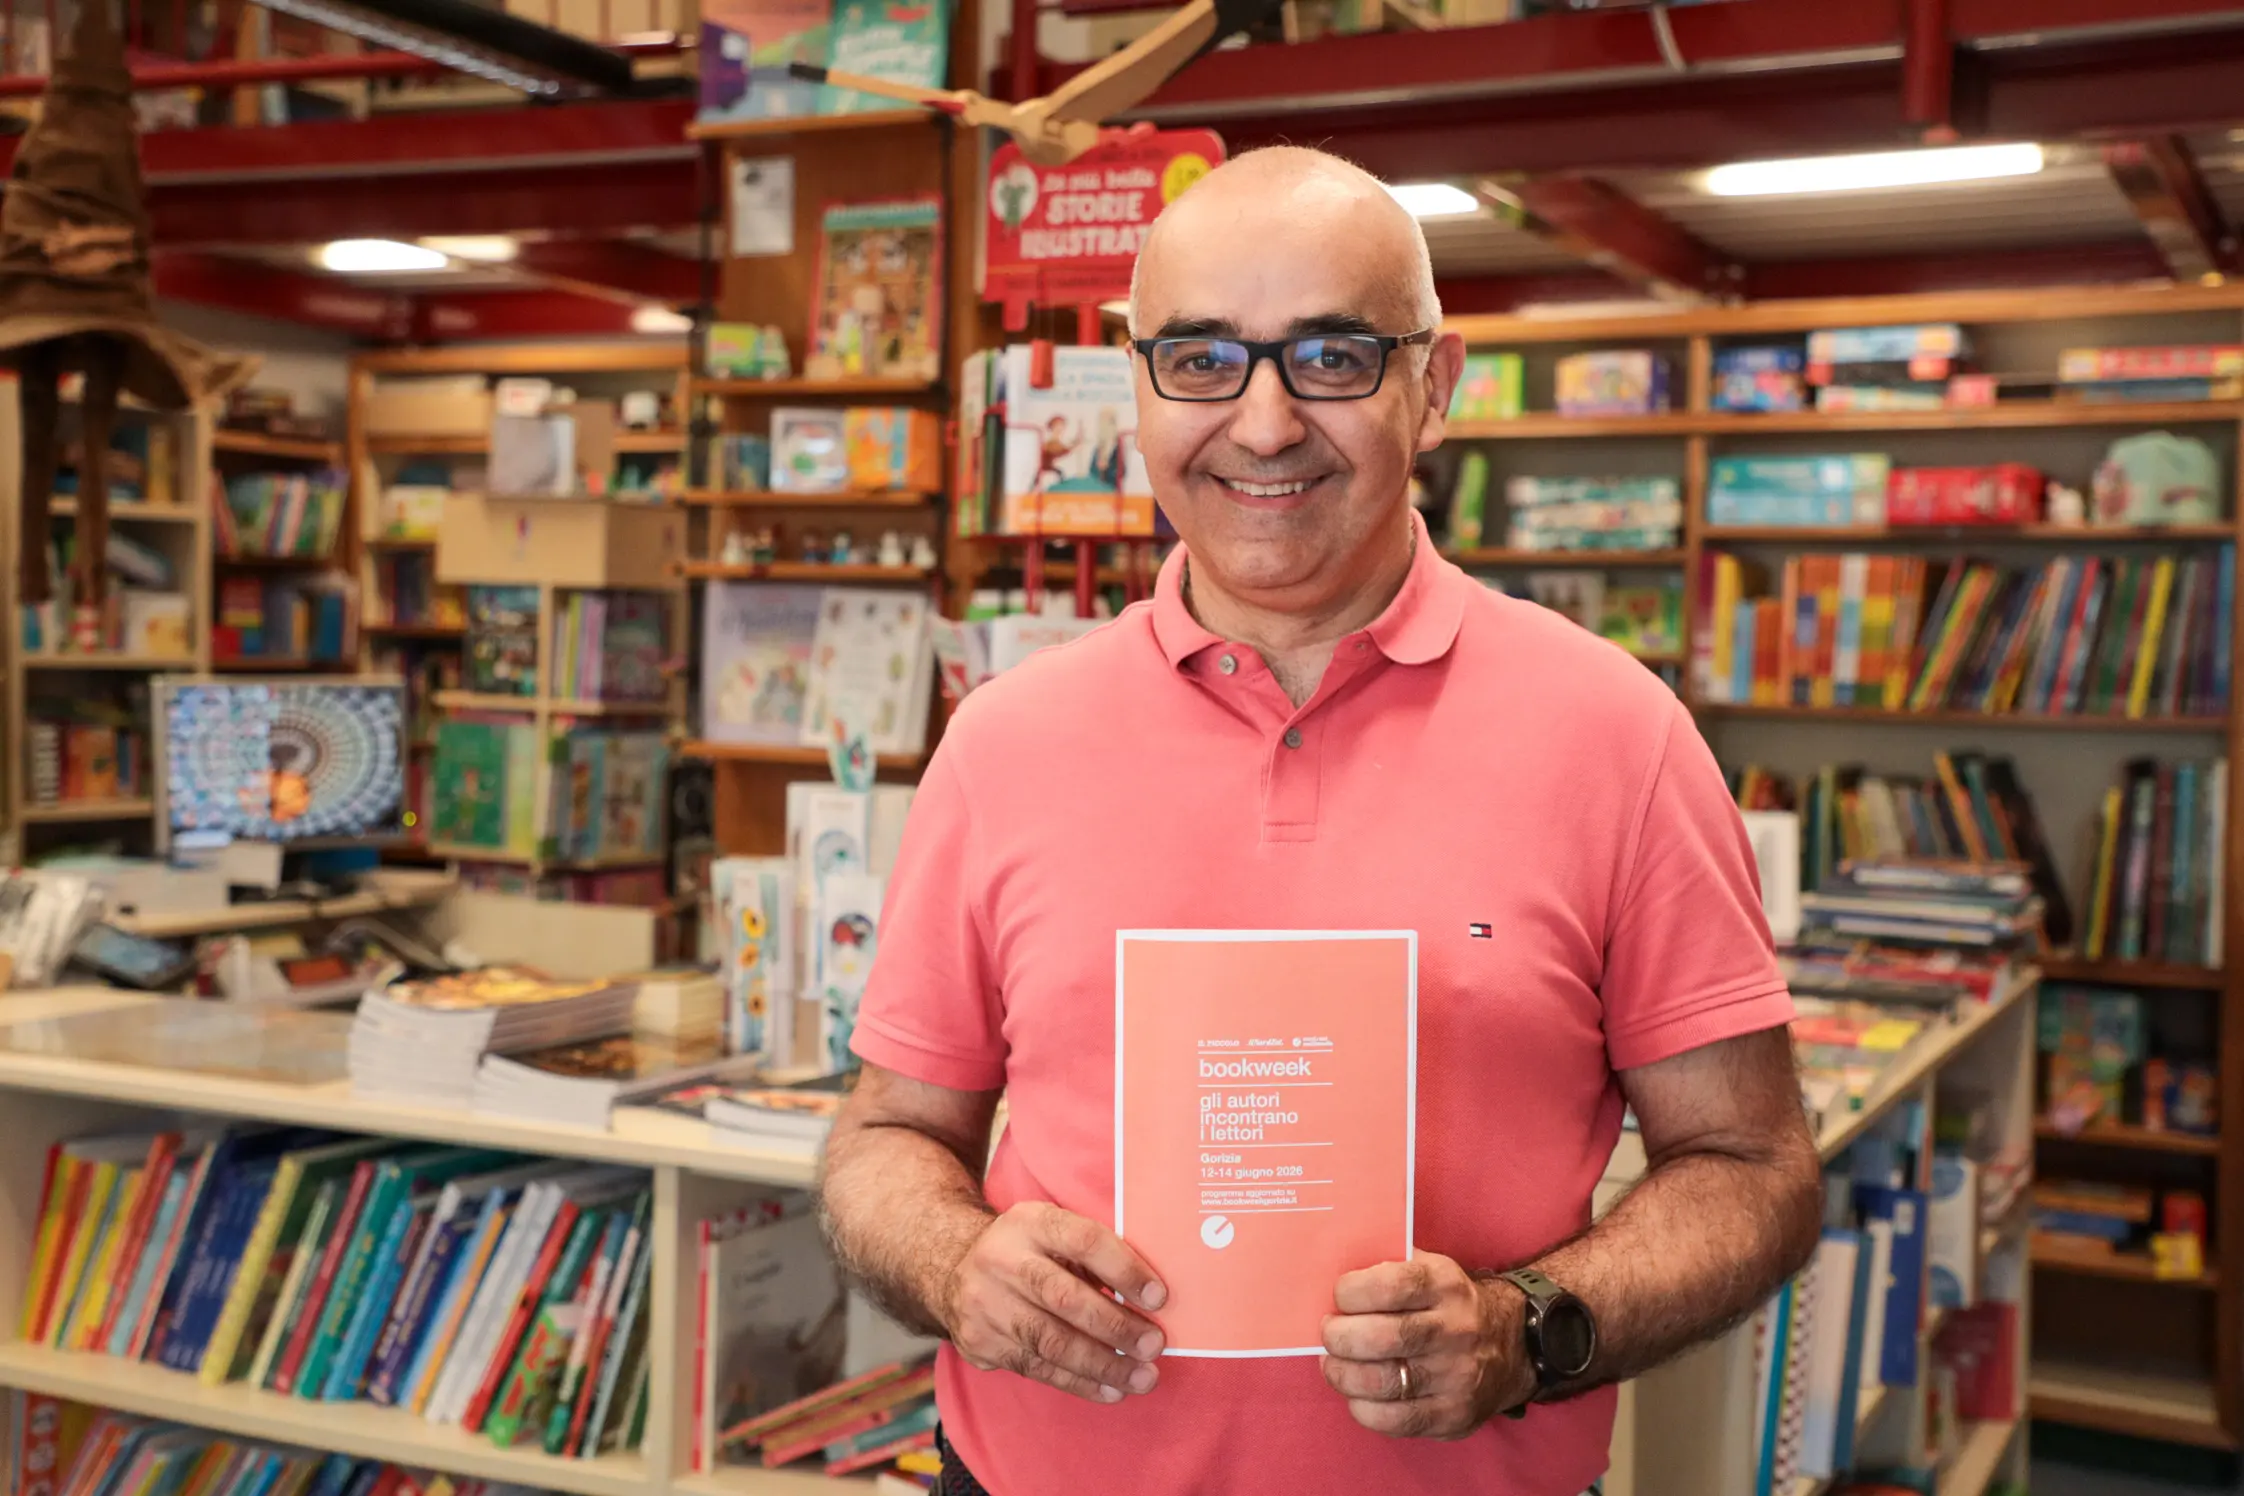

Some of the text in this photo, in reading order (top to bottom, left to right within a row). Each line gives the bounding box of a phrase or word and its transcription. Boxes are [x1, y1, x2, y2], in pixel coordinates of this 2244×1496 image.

[1047, 193, 1143, 224] STORIE
[1021, 225, 1150, 259] ILLUSTRAT
[1200, 1057, 1311, 1077] bookweek
[1200, 1092, 1279, 1112] gli autori
[1200, 1109, 1299, 1125] incontrano
[1200, 1124, 1264, 1141] i lettori
[1200, 1153, 1242, 1164] Gorizia
[1201, 1165, 1304, 1179] 12-14 giugno 2026
[1201, 1189, 1244, 1199] programma
[1286, 1187, 1296, 1196] su
